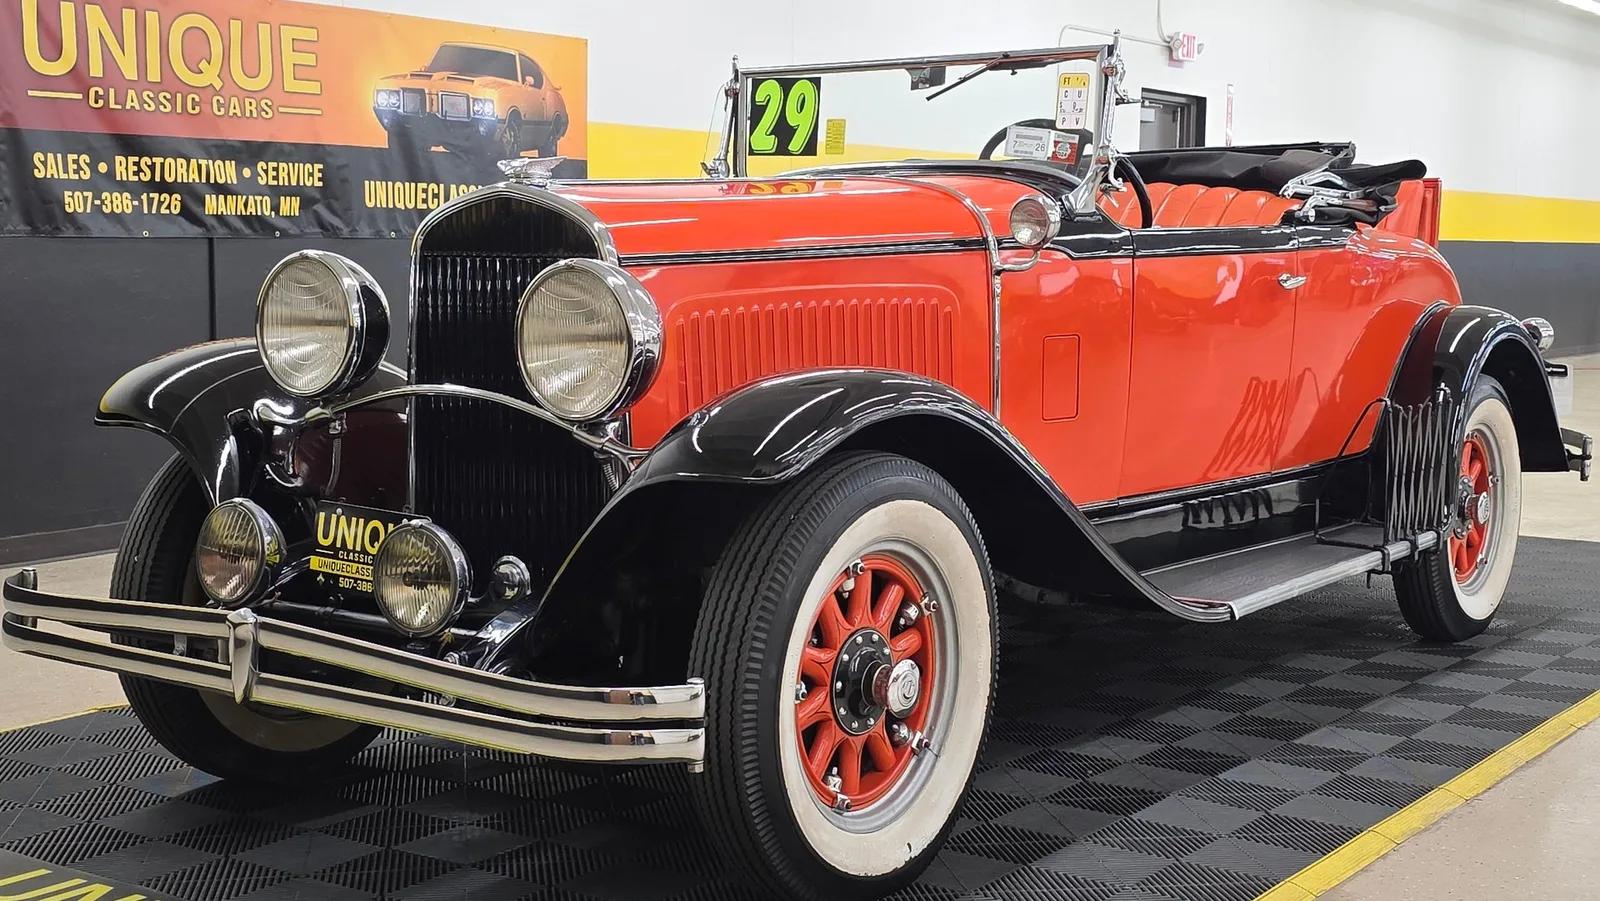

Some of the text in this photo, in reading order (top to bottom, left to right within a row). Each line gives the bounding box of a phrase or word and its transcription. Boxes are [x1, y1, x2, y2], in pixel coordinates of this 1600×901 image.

[21, 0, 321, 94] UNIQUE
[88, 86, 274, 119] CLASSIC CARS
[750, 79, 818, 155] 29
[33, 151, 324, 187] SALES RESTORATION SERVICE
[63, 190, 301, 218] 507-386-1726 MANKATO, MN
[317, 511, 394, 555] UNIQ
[338, 550, 374, 564] CLASSIC
